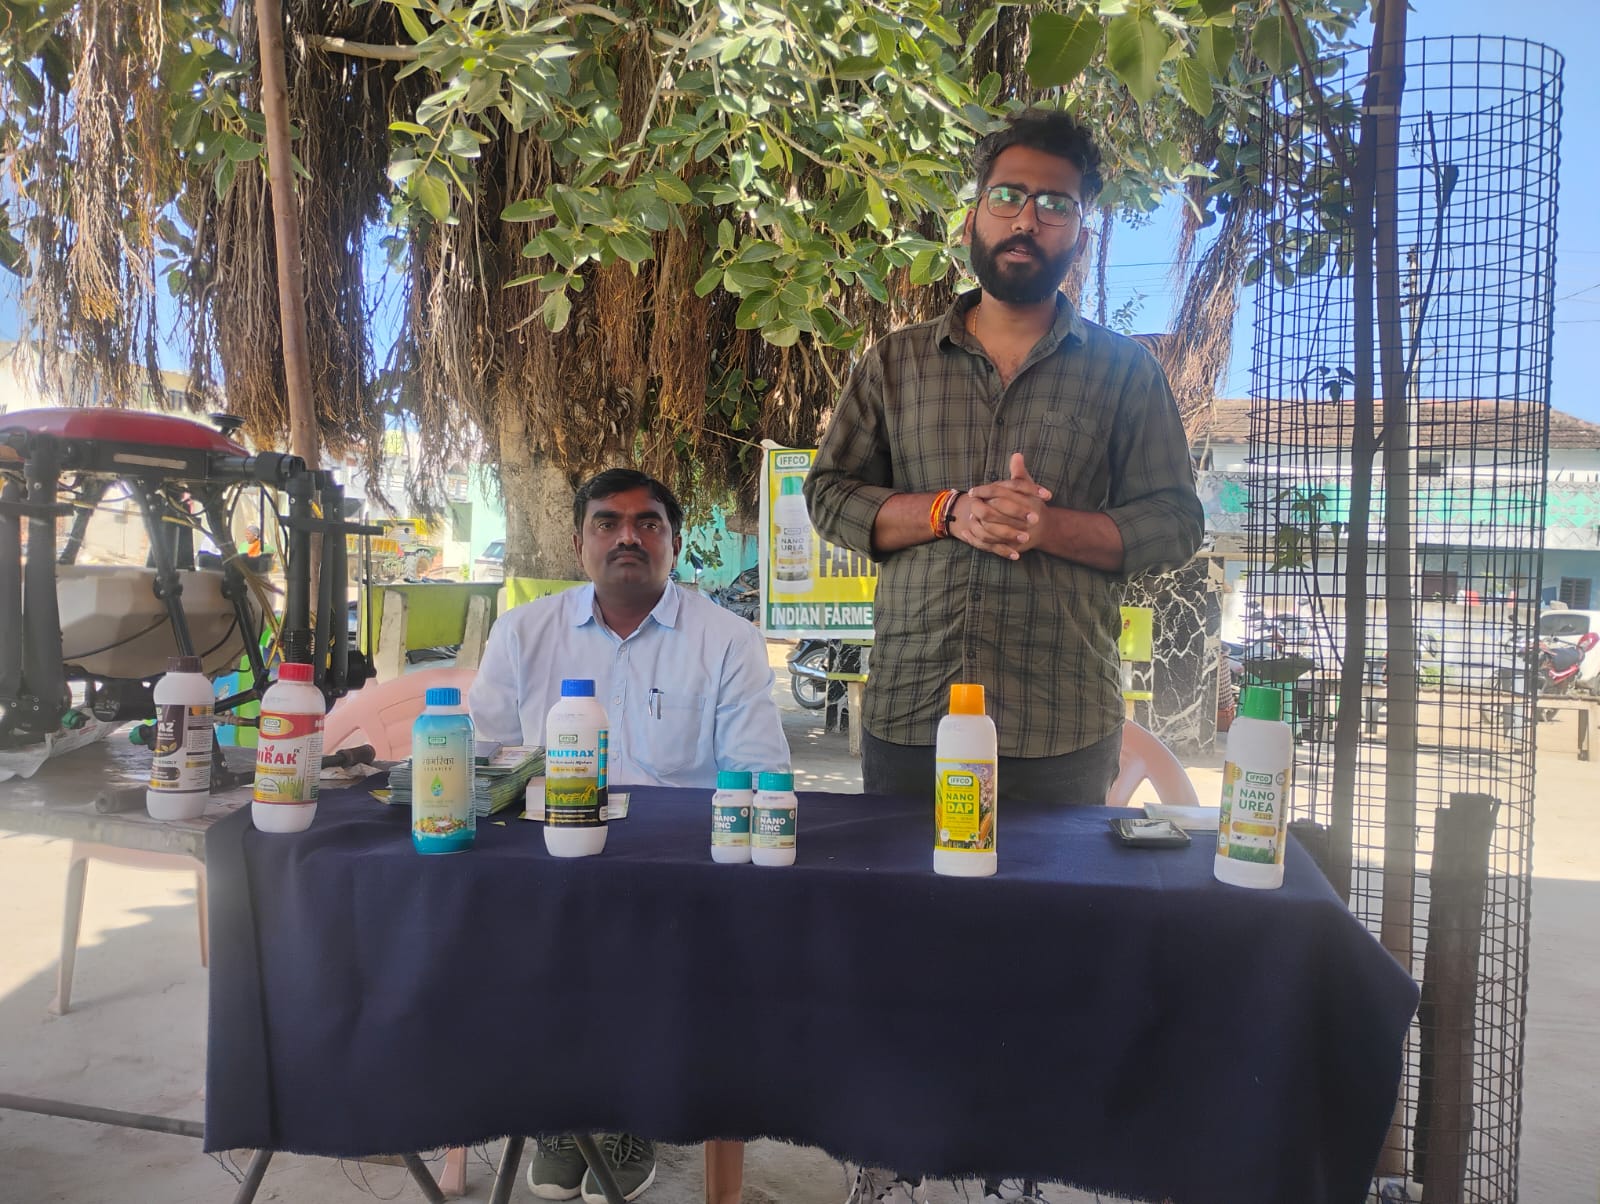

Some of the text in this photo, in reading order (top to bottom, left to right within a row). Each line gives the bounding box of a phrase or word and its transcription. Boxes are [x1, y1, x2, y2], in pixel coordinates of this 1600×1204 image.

[779, 455, 806, 465] IFFCO
[771, 606, 873, 625] INDIAN FARME
[548, 749, 594, 758] NEUTRAX
[950, 777, 970, 785] IFFCO
[1249, 775, 1269, 783] IFFCO
[946, 793, 974, 801] NANO
[1239, 788, 1275, 801] NANO
[947, 802, 973, 814] DAP
[1239, 800, 1274, 813] UREA
[760, 817, 786, 825] NANO
[760, 824, 781, 832] ZINC
